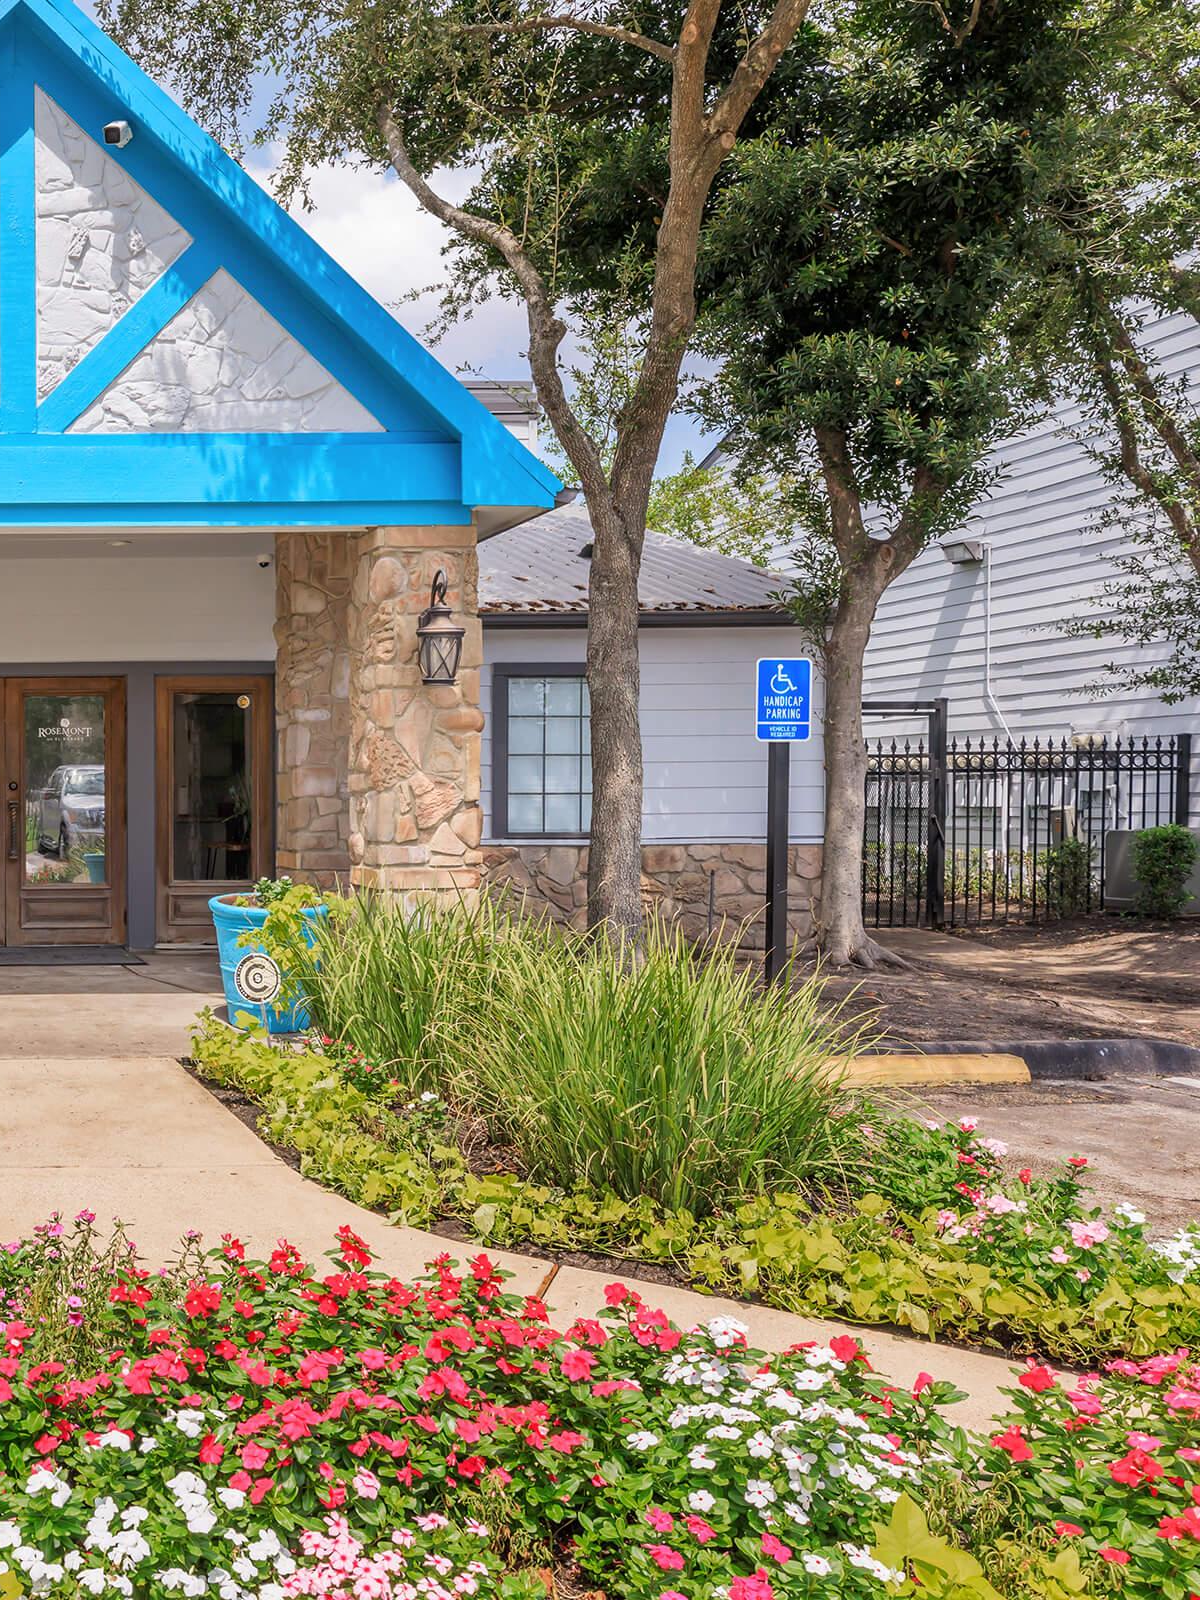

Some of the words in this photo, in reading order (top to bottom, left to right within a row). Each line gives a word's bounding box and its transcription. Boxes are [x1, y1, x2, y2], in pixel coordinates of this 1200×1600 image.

[763, 695, 804, 706] HANDICAP
[766, 708, 801, 719] PARKING
[38, 727, 92, 738] ROSEMONT
